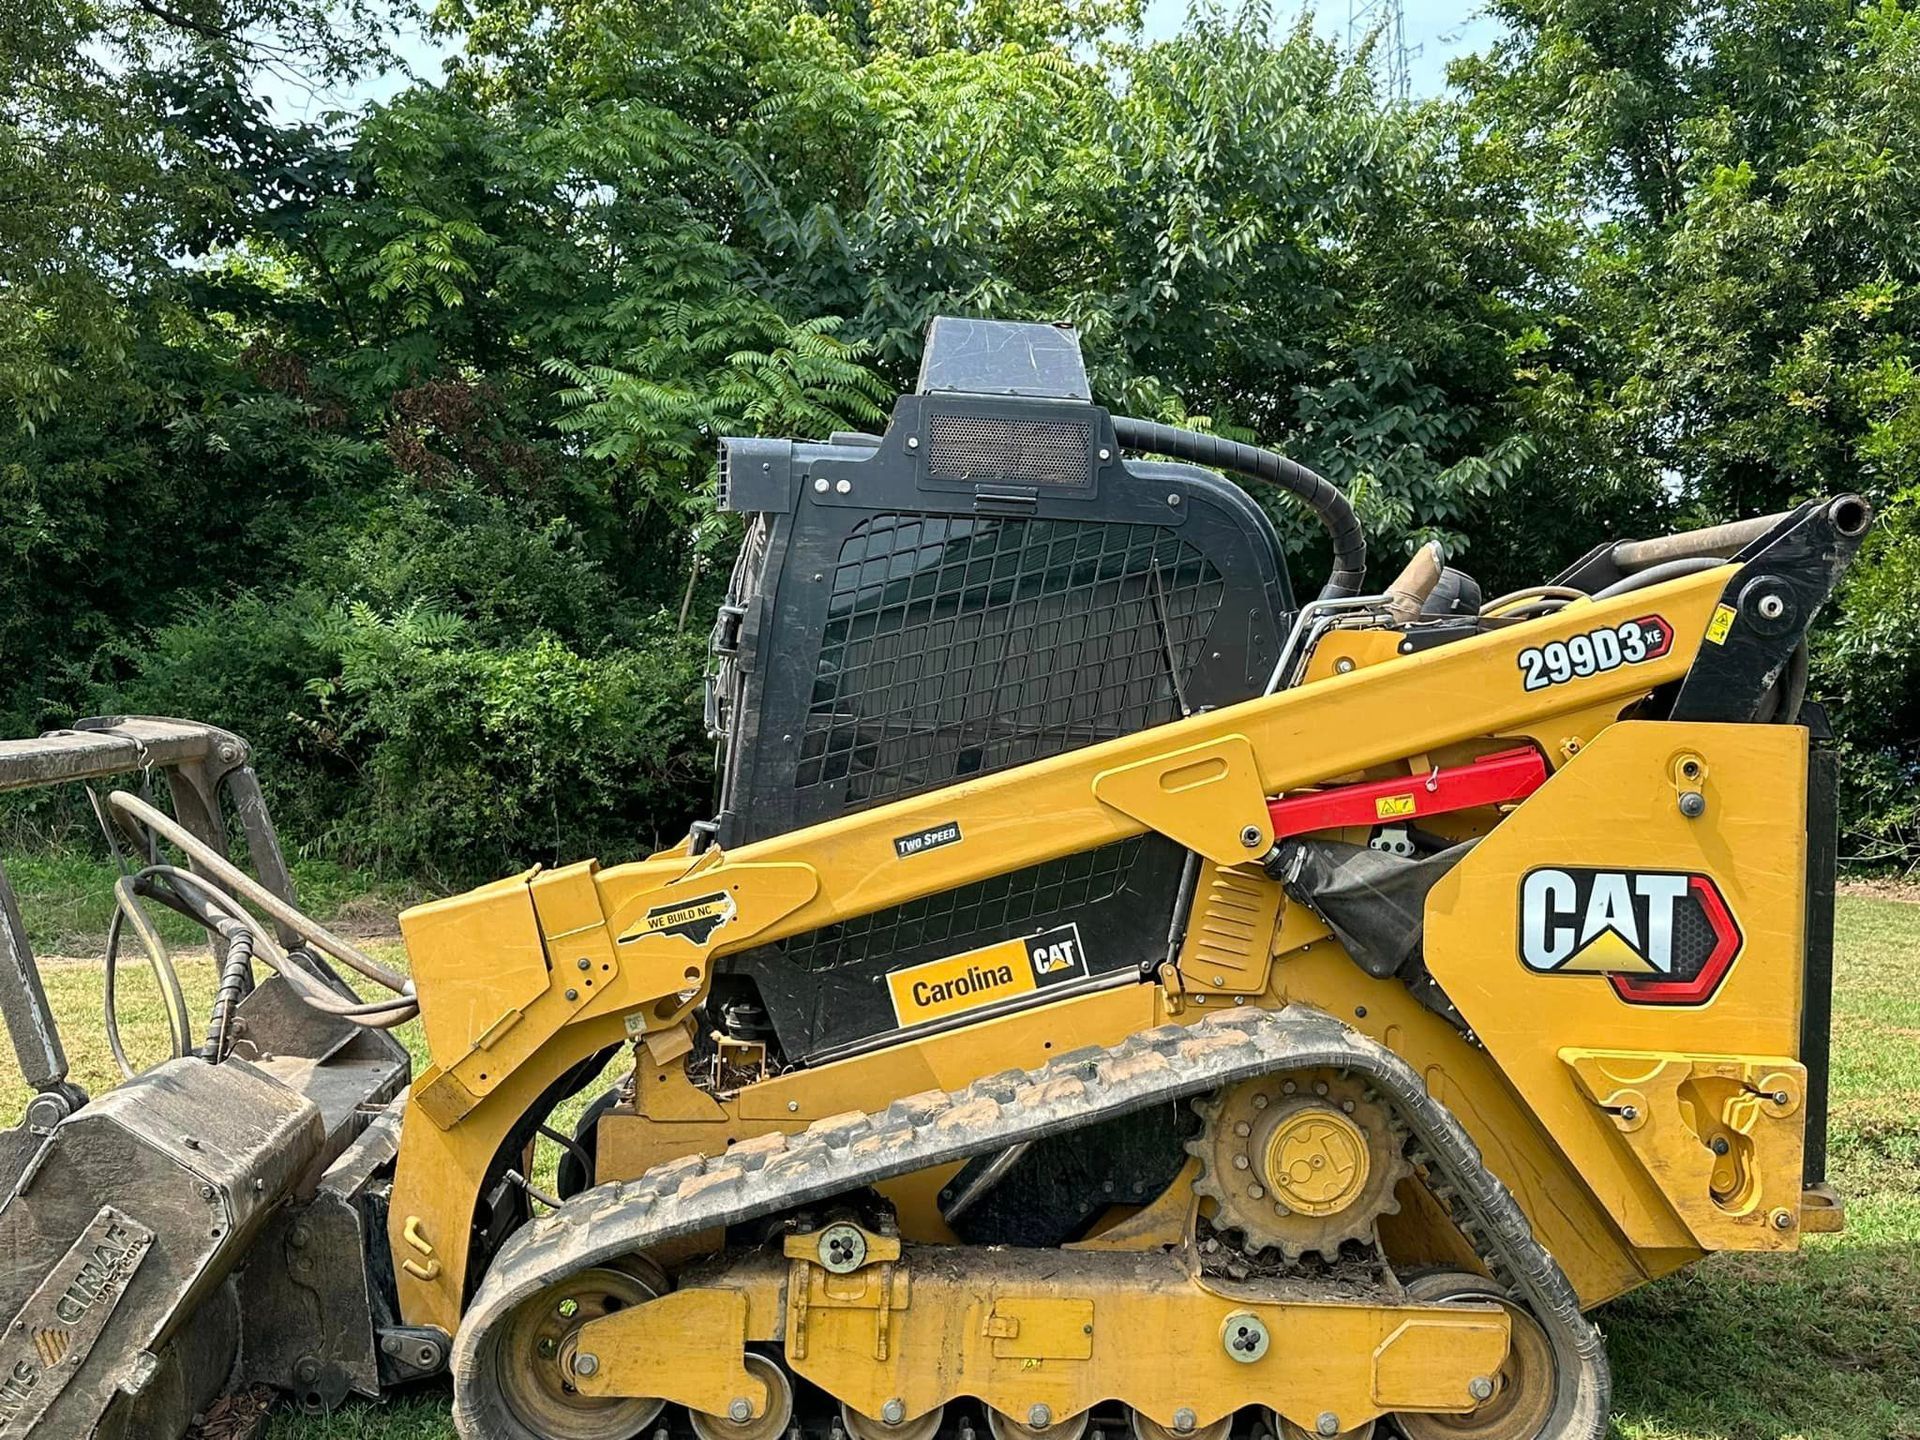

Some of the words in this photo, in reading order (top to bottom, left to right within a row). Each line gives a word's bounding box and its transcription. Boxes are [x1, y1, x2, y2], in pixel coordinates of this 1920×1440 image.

[1520, 622, 1646, 690] 299D3
[1644, 629, 1662, 645] XE
[899, 838, 921, 853] TWO
[924, 828, 956, 846] SPEED
[648, 916, 665, 929] WE
[667, 909, 696, 925] BUILD
[698, 905, 712, 917] NC
[1523, 869, 1688, 973] CAT
[913, 964, 1013, 1006] Carolina
[1033, 940, 1074, 975] CAT
